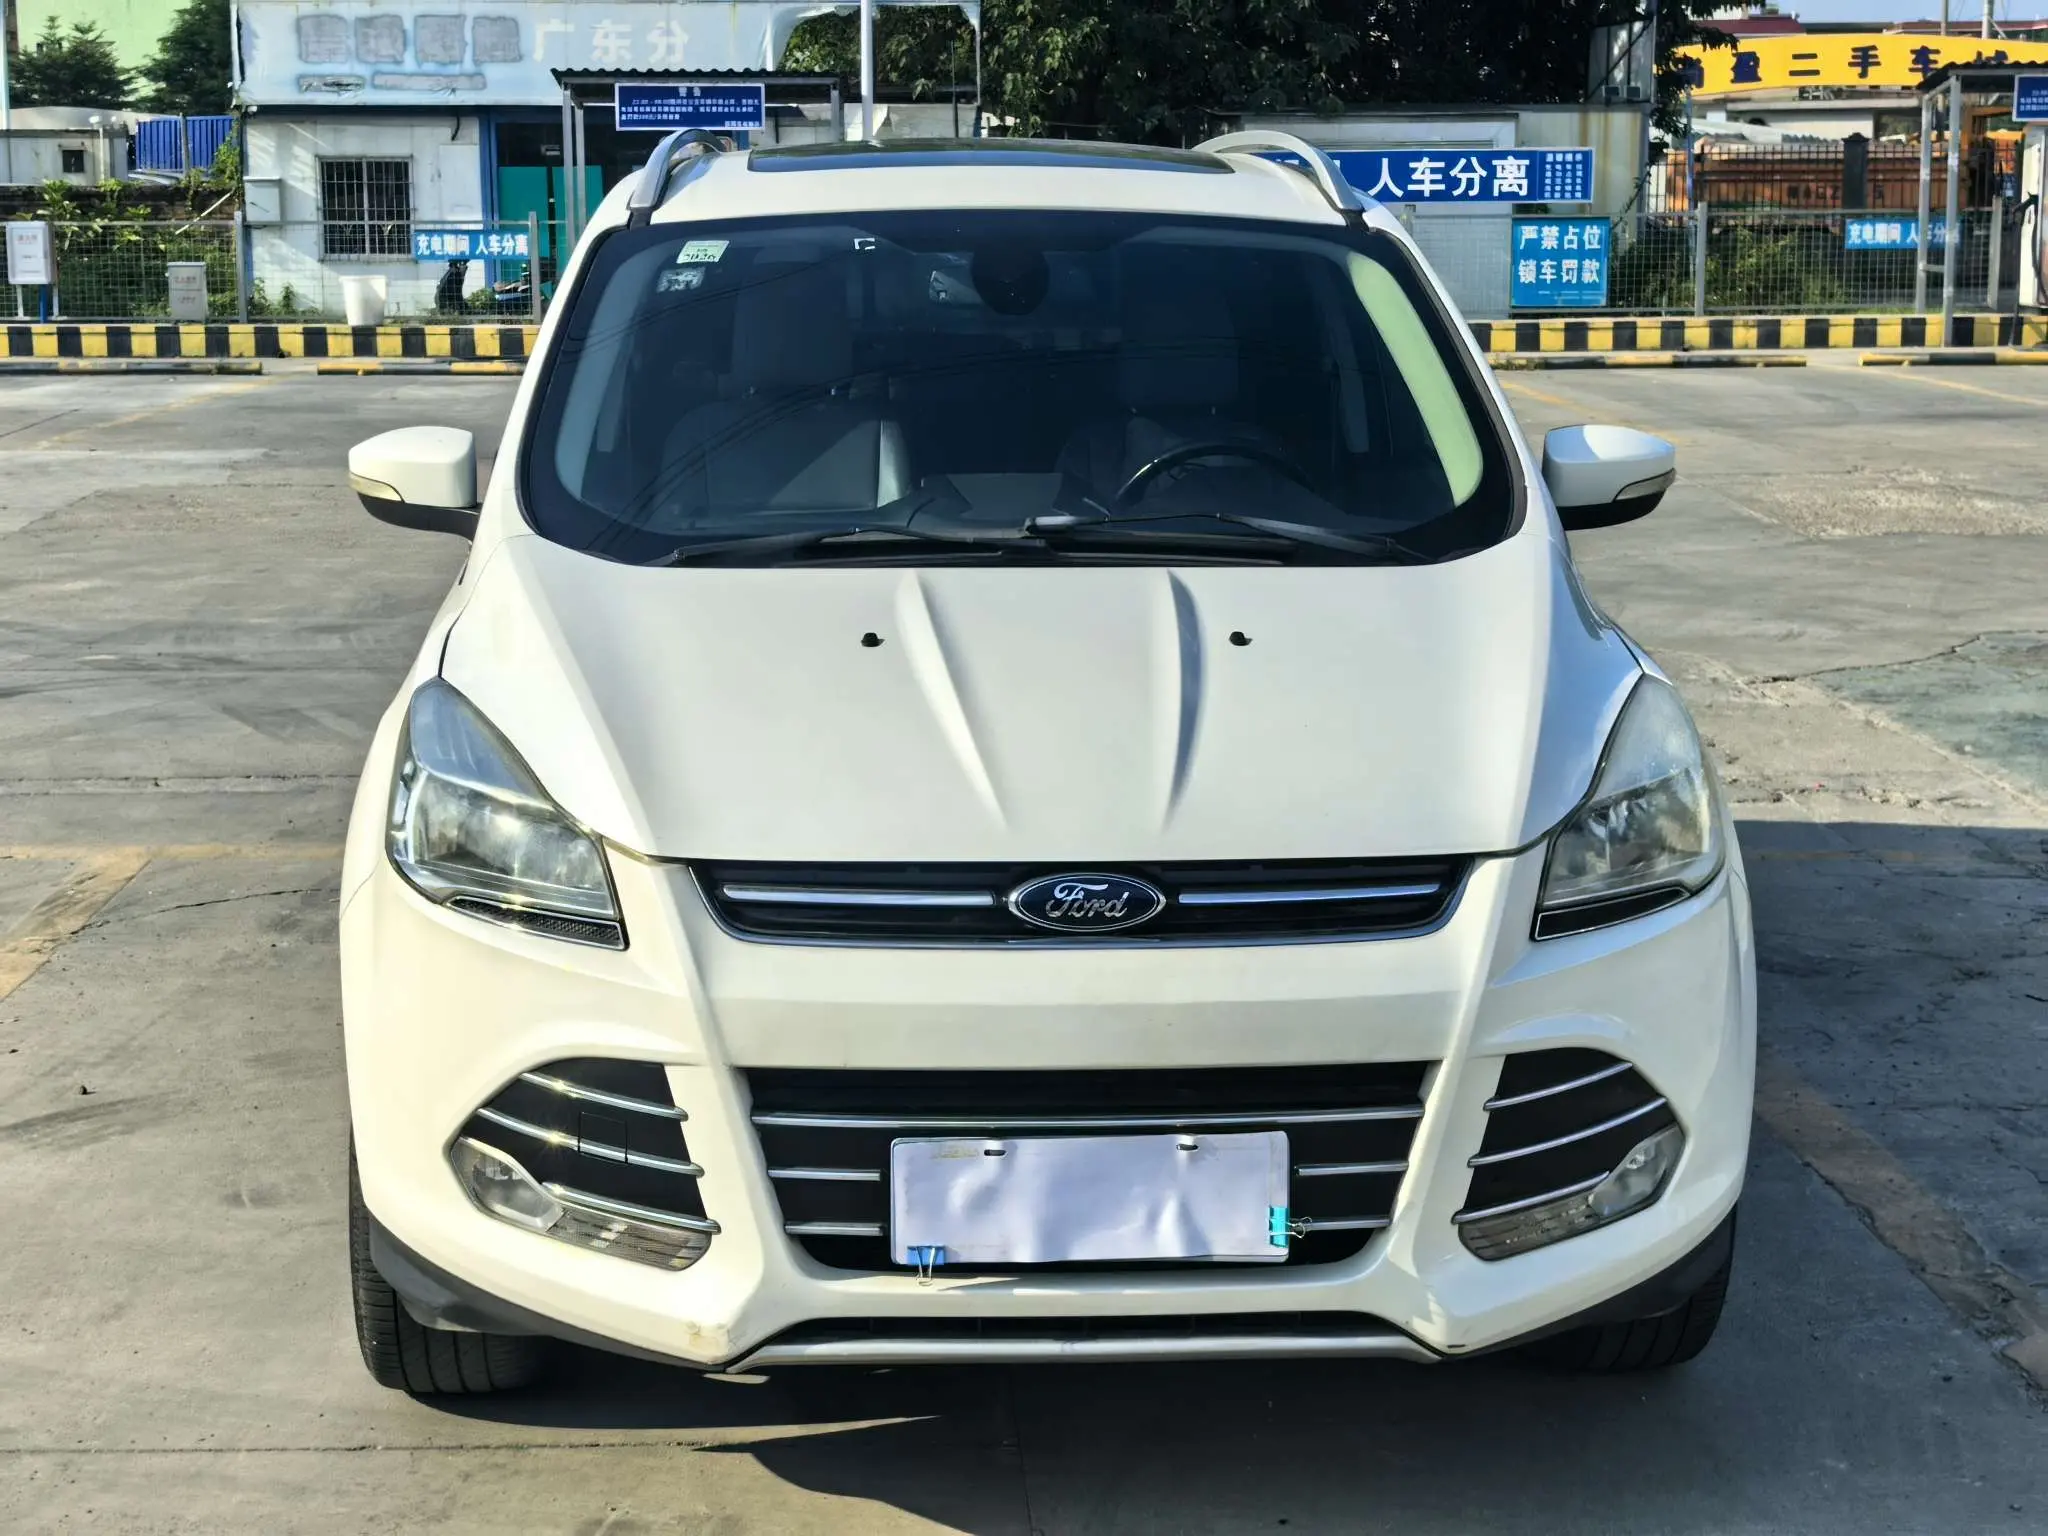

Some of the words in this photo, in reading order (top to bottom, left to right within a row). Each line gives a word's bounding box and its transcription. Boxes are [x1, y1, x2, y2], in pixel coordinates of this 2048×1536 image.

[1368, 156, 1531, 198] 人车分离
[417, 233, 470, 255] 充电期间
[475, 233, 528, 255] 人车分离
[1519, 224, 1602, 250] 严禁占位
[1518, 258, 1600, 284] 锁车罚款
[1046, 883, 1130, 918] Ford
